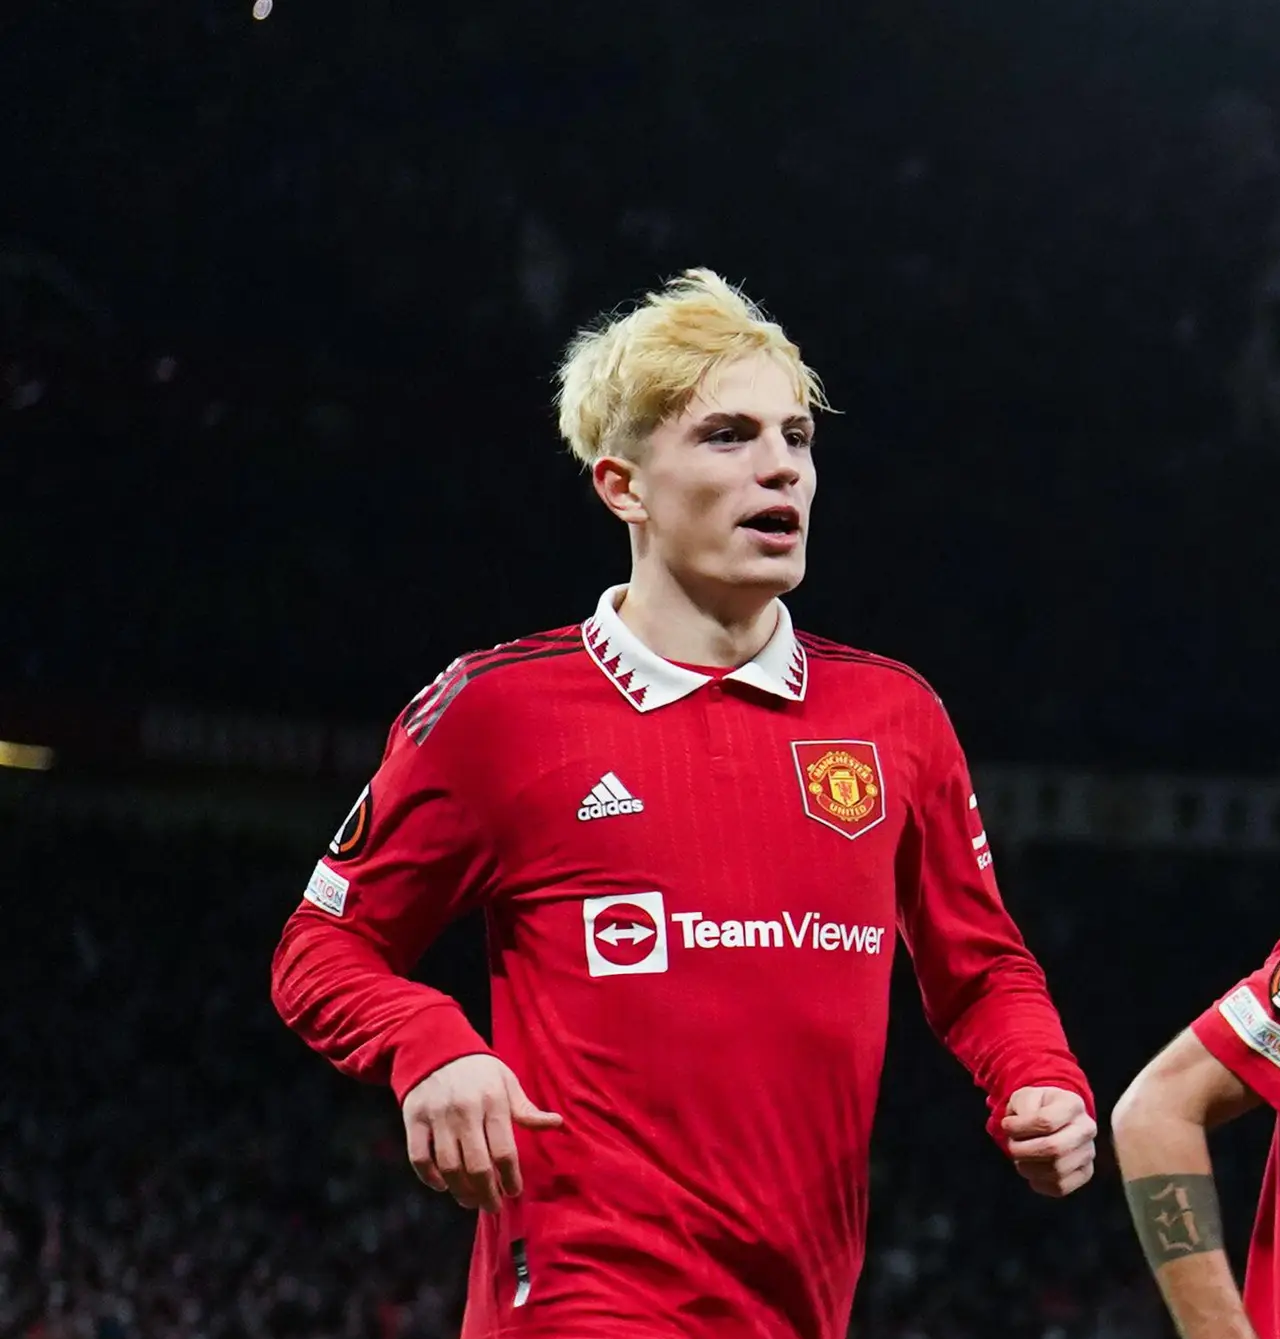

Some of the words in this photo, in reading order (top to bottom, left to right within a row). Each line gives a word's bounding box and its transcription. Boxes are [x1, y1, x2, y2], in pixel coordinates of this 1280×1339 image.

[813, 755, 869, 777] MANCHESTER
[577, 798, 644, 821] adidas
[829, 803, 866, 816] UNITED
[671, 911, 885, 954] TeamViewer
